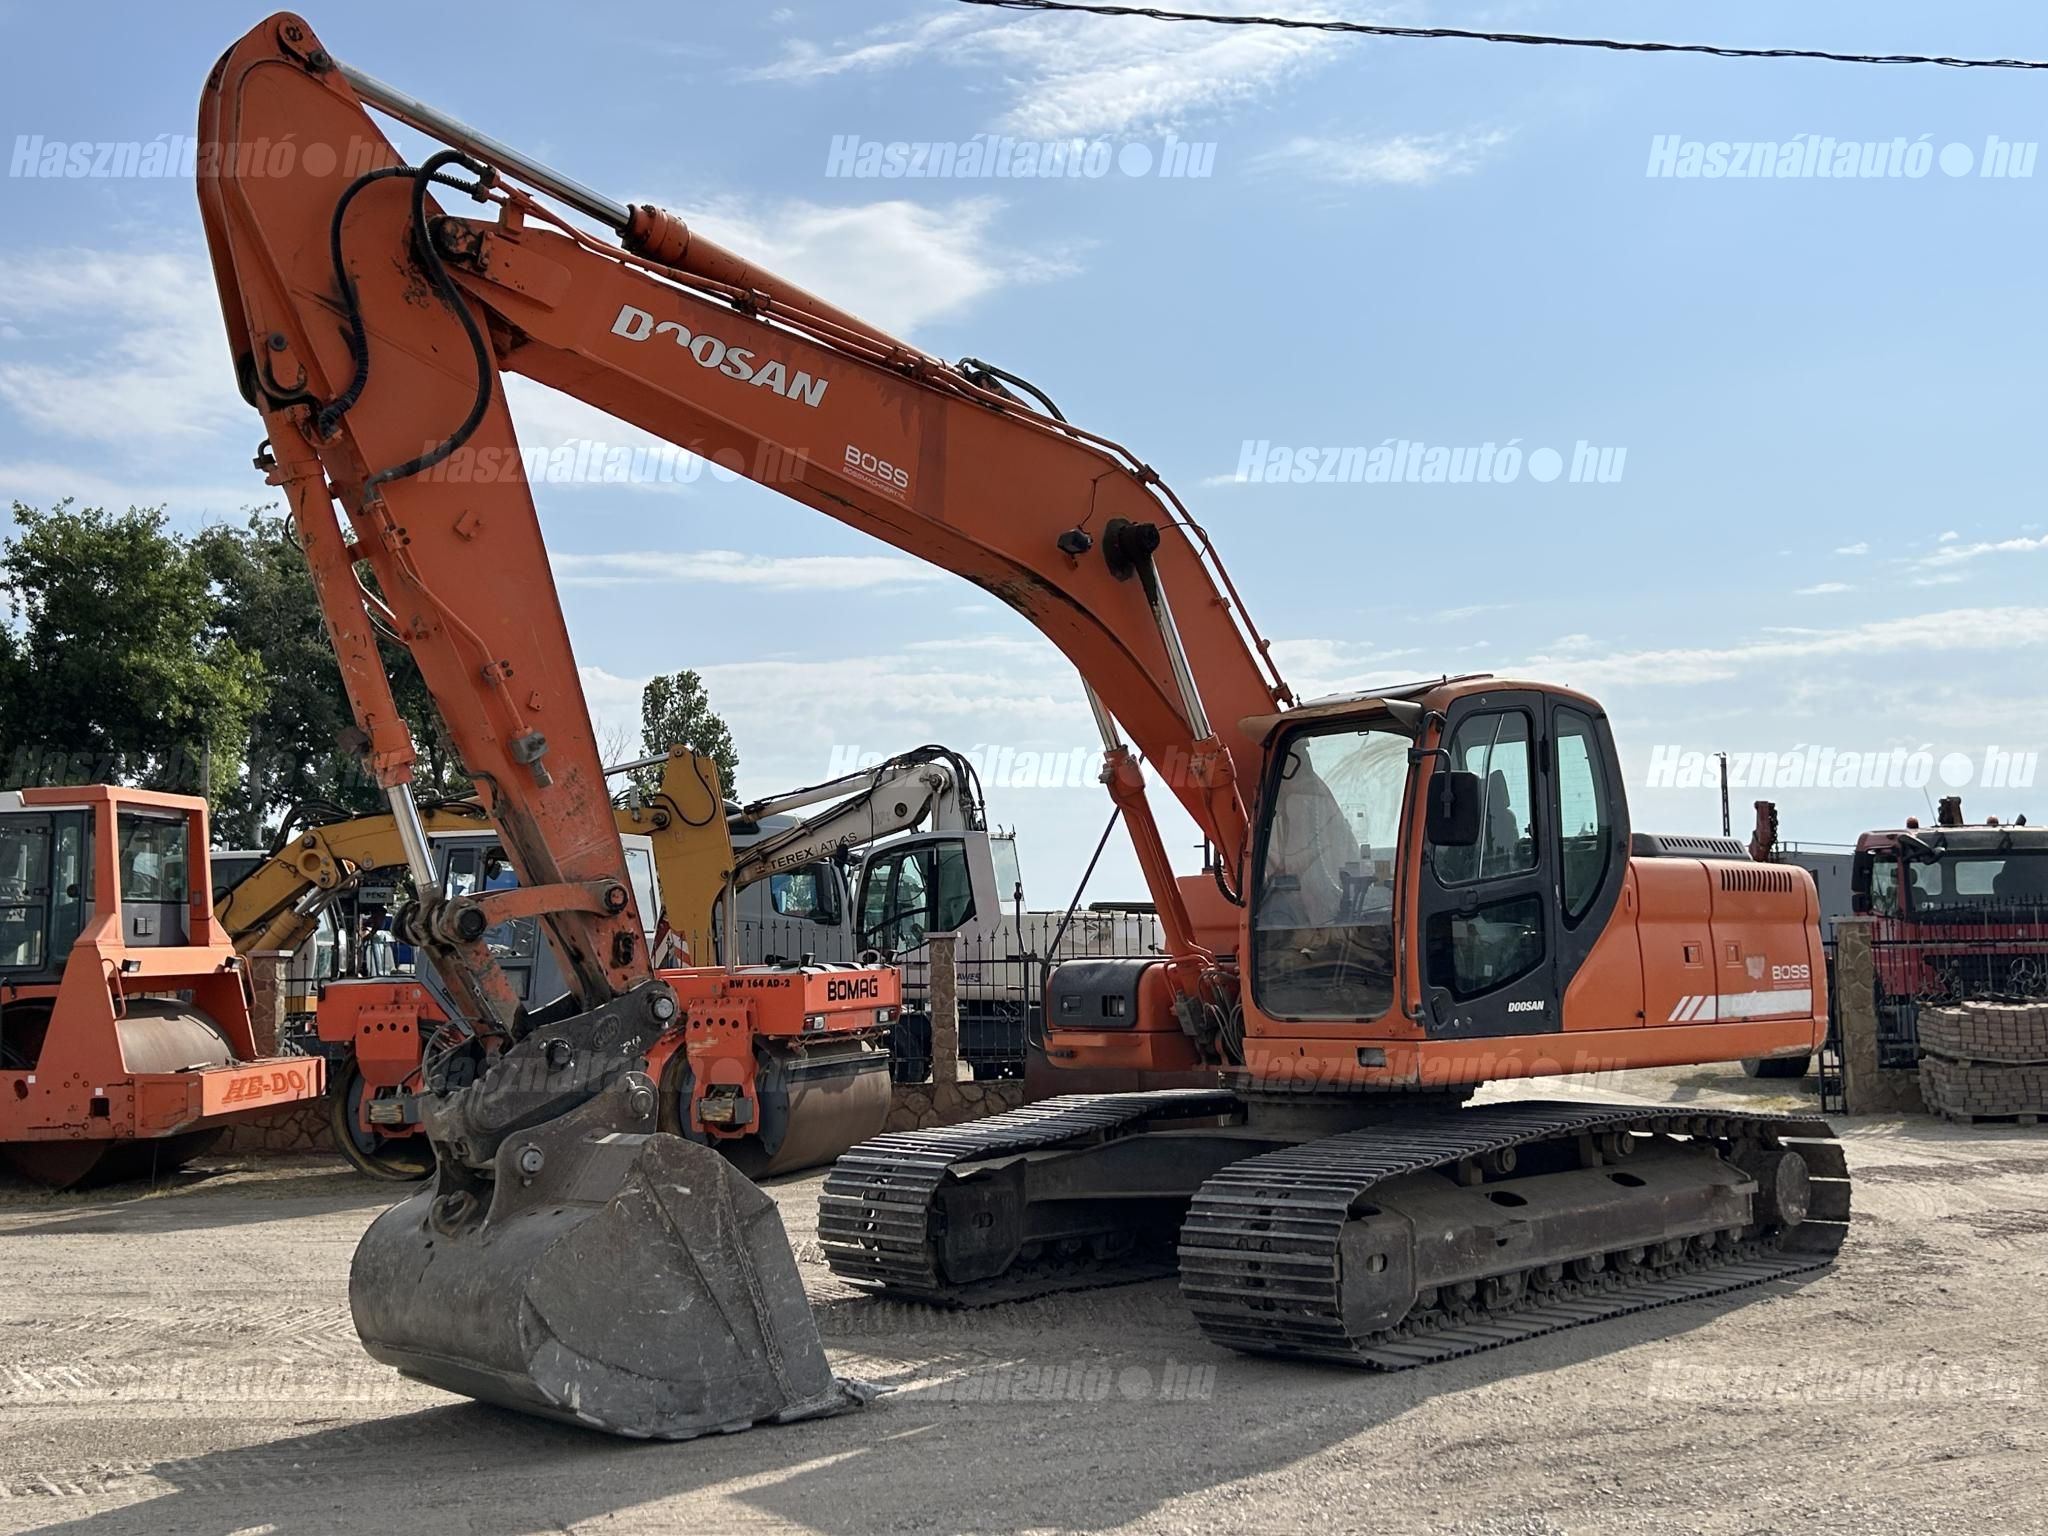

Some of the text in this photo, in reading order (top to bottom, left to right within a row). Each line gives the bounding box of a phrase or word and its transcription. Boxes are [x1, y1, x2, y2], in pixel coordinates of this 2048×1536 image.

[845, 445, 909, 488] BOSS
[771, 847, 814, 869] TEREX
[729, 978, 790, 989] BW 164 AD-2
[1772, 965, 1809, 980] BOSS
[827, 976, 878, 1001] BOMAG
[1508, 1000, 1544, 1012] DOOSAN
[221, 1070, 306, 1104] HE-DO
